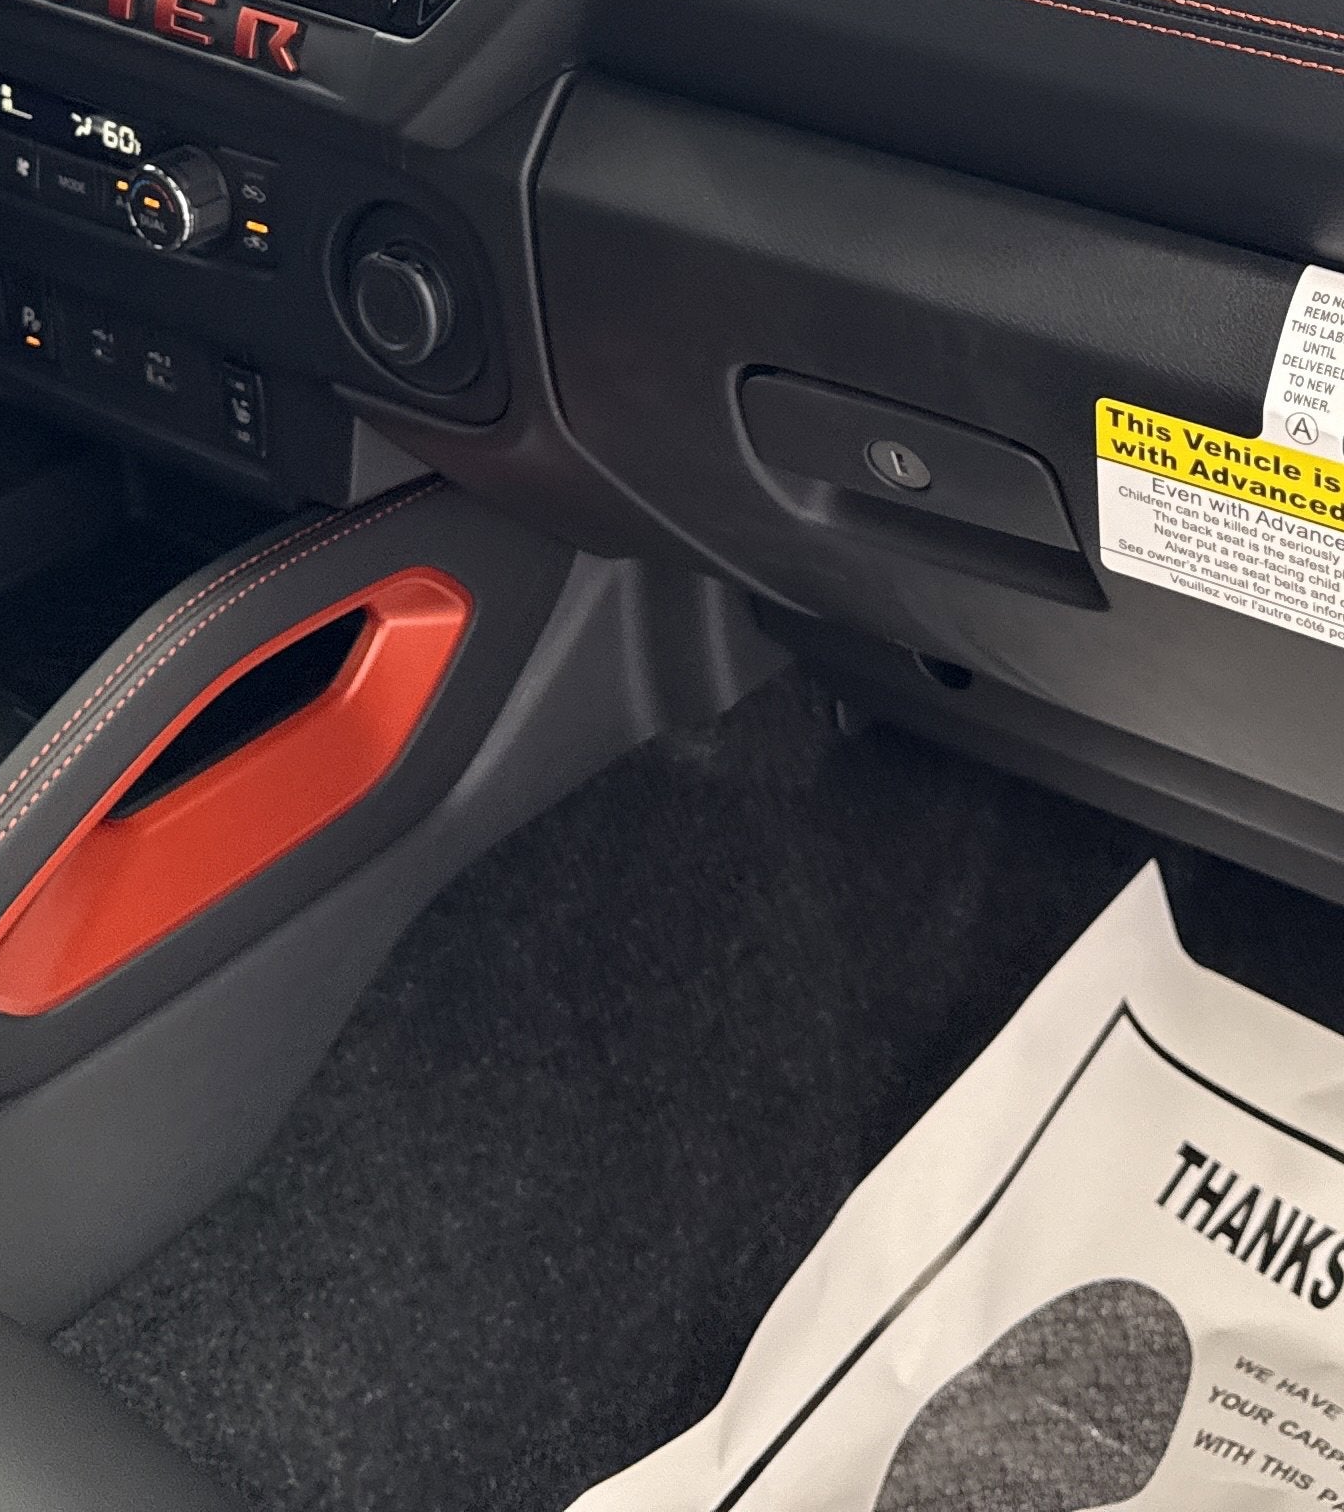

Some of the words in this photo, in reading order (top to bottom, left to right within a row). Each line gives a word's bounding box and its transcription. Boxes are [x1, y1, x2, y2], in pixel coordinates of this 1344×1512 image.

[1312, 291, 1330, 304] DO
[1291, 320, 1317, 336] THIS
[1303, 341, 1336, 360] UNTIL
[1283, 390, 1331, 413] OWNER.
[1289, 373, 1304, 387] TO
[1307, 378, 1335, 395] NEW
[1106, 405, 1172, 443] This
[1183, 428, 1302, 481] Vehicle
[1314, 467, 1341, 493] is
[1111, 438, 1177, 471] with
[1119, 485, 1171, 511] Children
[1176, 505, 1199, 520] can
[1203, 511, 1220, 525] be
[1224, 516, 1258, 538] killed
[1262, 531, 1276, 543] or
[1280, 537, 1340, 565] seriously
[1152, 477, 1202, 506] Even
[1208, 497, 1249, 521] with
[1153, 509, 1178, 526] The
[1182, 518, 1213, 537] back
[1216, 531, 1245, 548] seat
[1249, 538, 1260, 553] is
[1264, 544, 1284, 560] the
[1289, 554, 1330, 575] safest
[1154, 522, 1193, 544] Never
[1196, 538, 1217, 554] put
[1220, 546, 1229, 556] a
[1232, 550, 1305, 582] rear-facing
[1308, 575, 1340, 593] child
[1118, 538, 1144, 555] See
[1147, 549, 1198, 573] owner's
[1201, 567, 1249, 590] manual
[1253, 582, 1271, 596] for
[1275, 591, 1309, 609] more
[1165, 540, 1211, 564] Always
[1215, 558, 1239, 572] use
[1242, 566, 1271, 584] seat
[1274, 575, 1306, 595] belts
[1310, 589, 1336, 605] and
[1170, 573, 1221, 598] Veuillez
[1223, 591, 1248, 607] voir
[1251, 599, 1292, 621] l'autre
[1296, 617, 1325, 633] côté
[1207, 1384, 1274, 1426] YOUR
[1234, 1355, 1275, 1384] WE
[1275, 1377, 1344, 1422] HAVE
[1192, 1428, 1257, 1466] WITH
[1259, 1453, 1316, 1491] THIS
